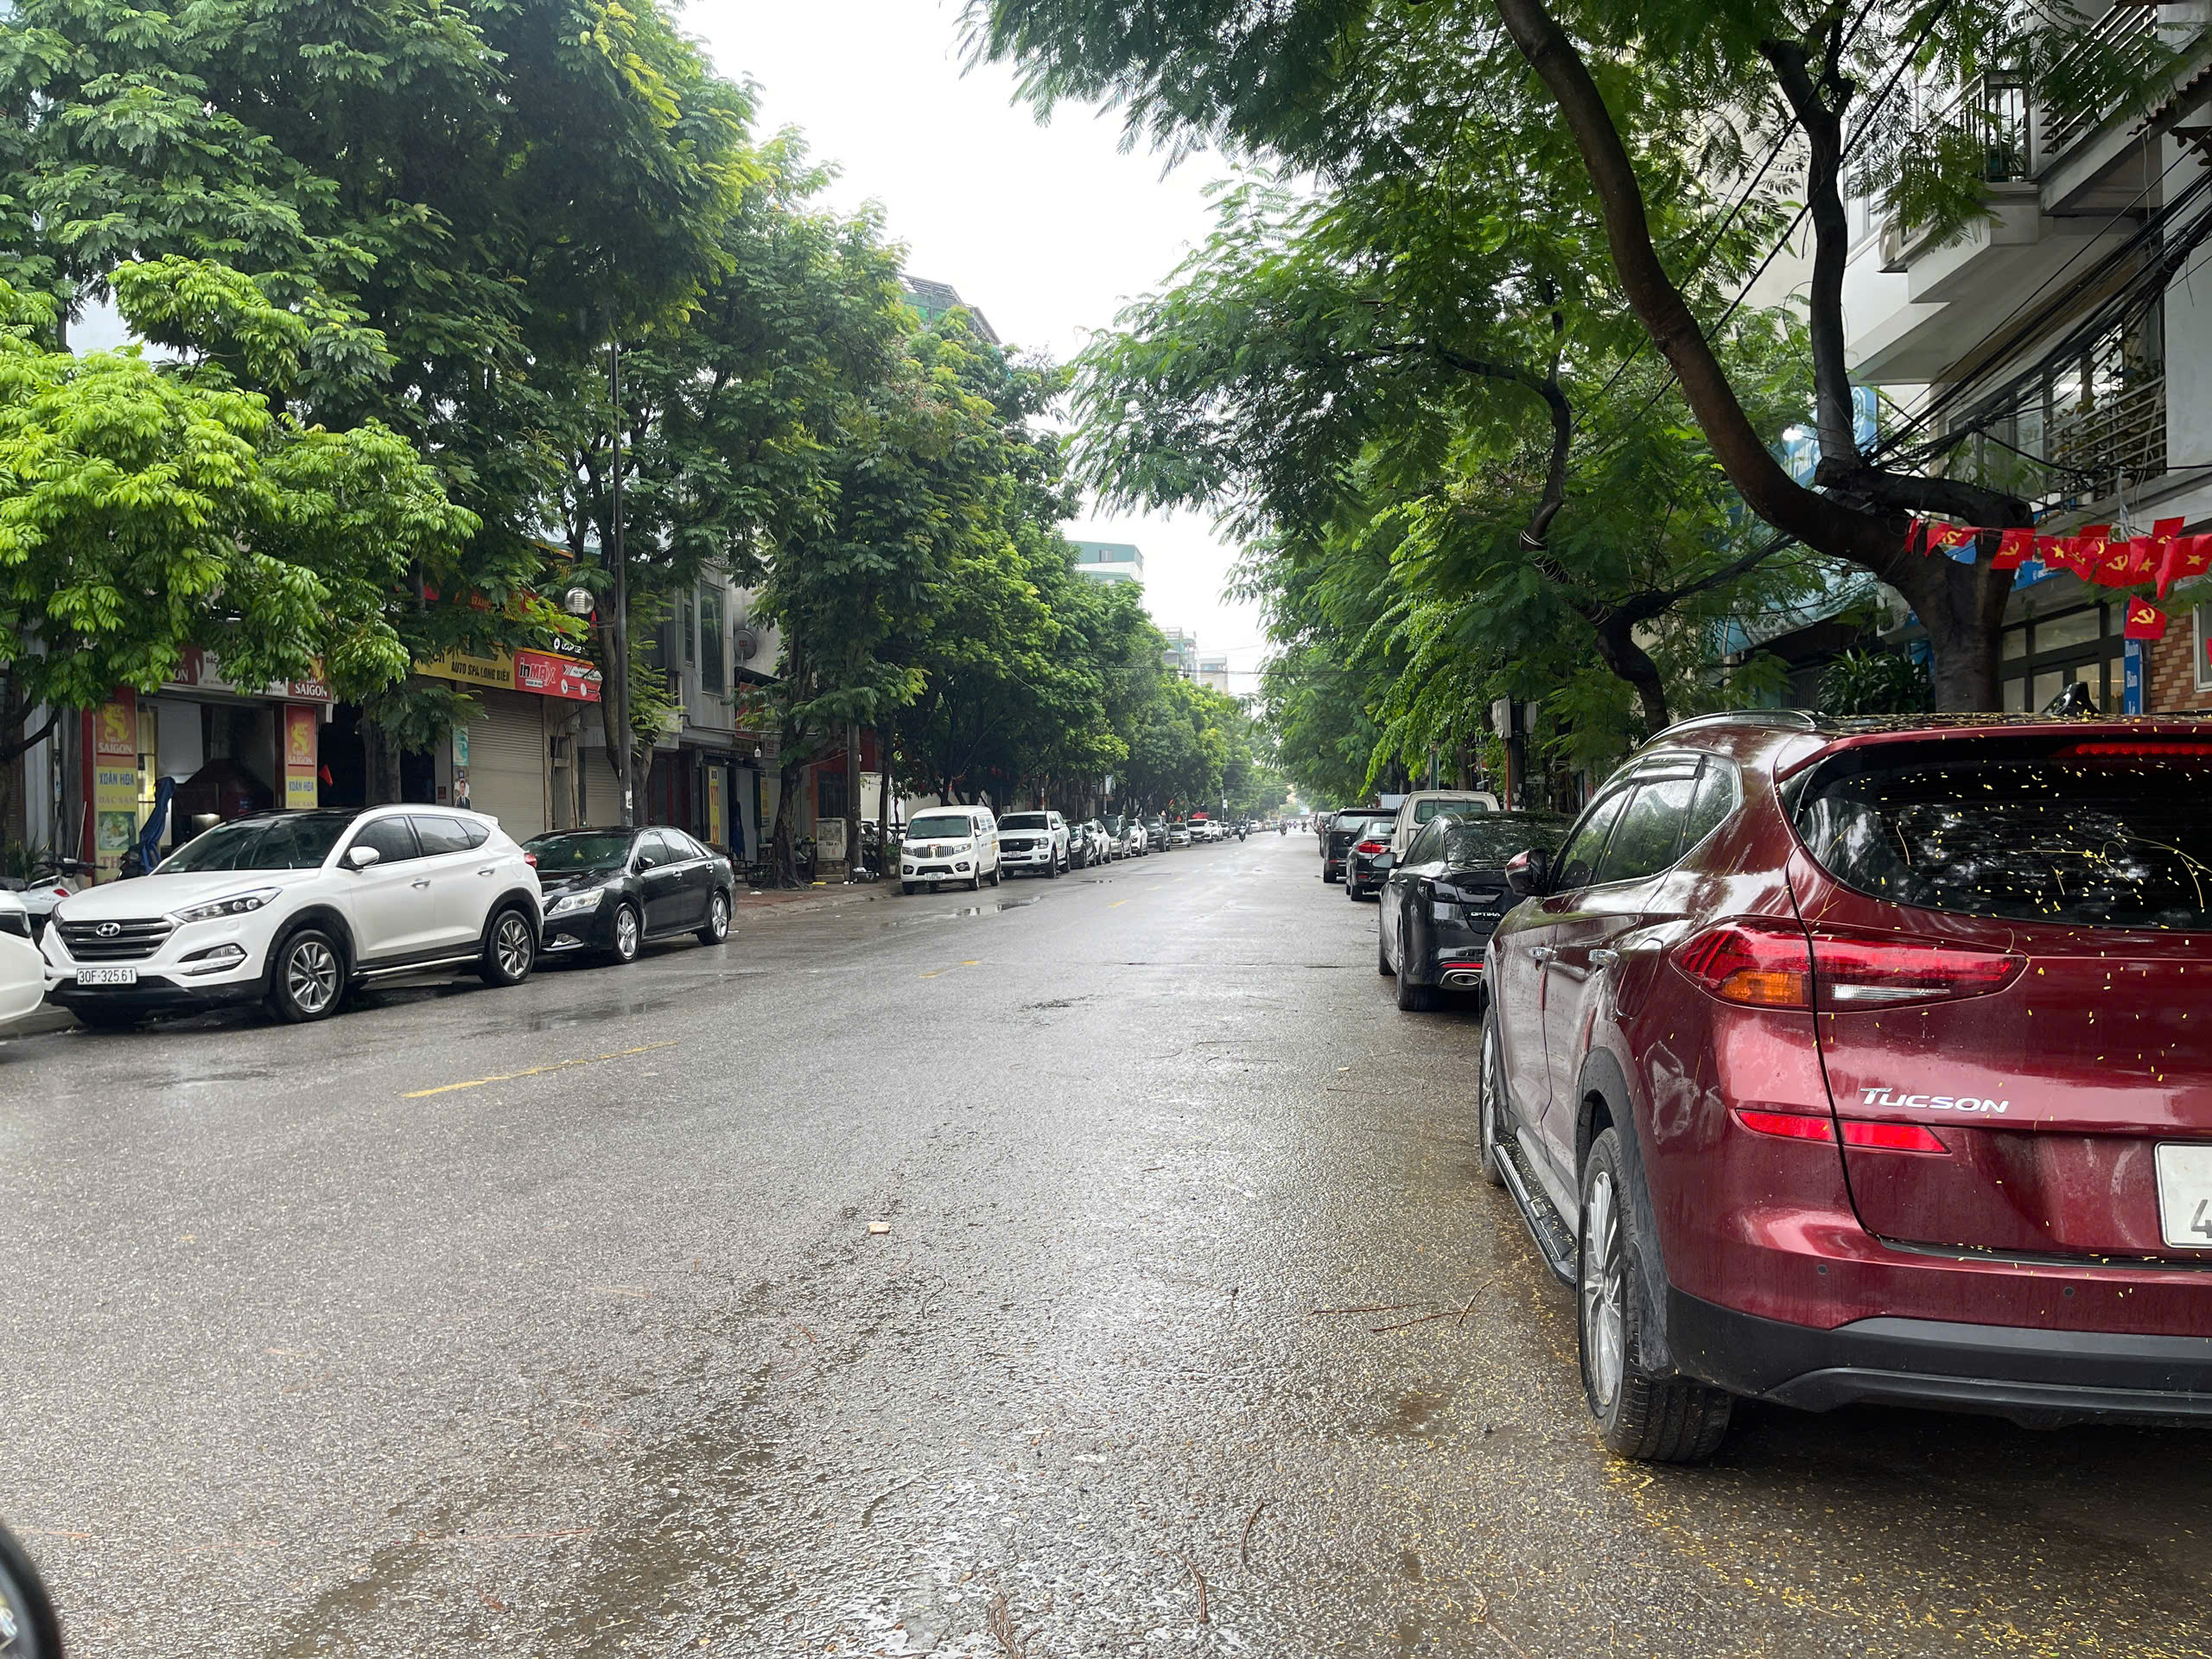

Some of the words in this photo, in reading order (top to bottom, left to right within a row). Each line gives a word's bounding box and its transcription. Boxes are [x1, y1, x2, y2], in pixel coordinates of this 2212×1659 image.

[451, 661, 467, 675] AUTO
[467, 664, 480, 677] SPA
[480, 667, 495, 680] LONG
[295, 683, 327, 697] SAIGON
[98, 742, 132, 753] SAIGON
[1859, 1086, 2011, 1114] TUCSON
